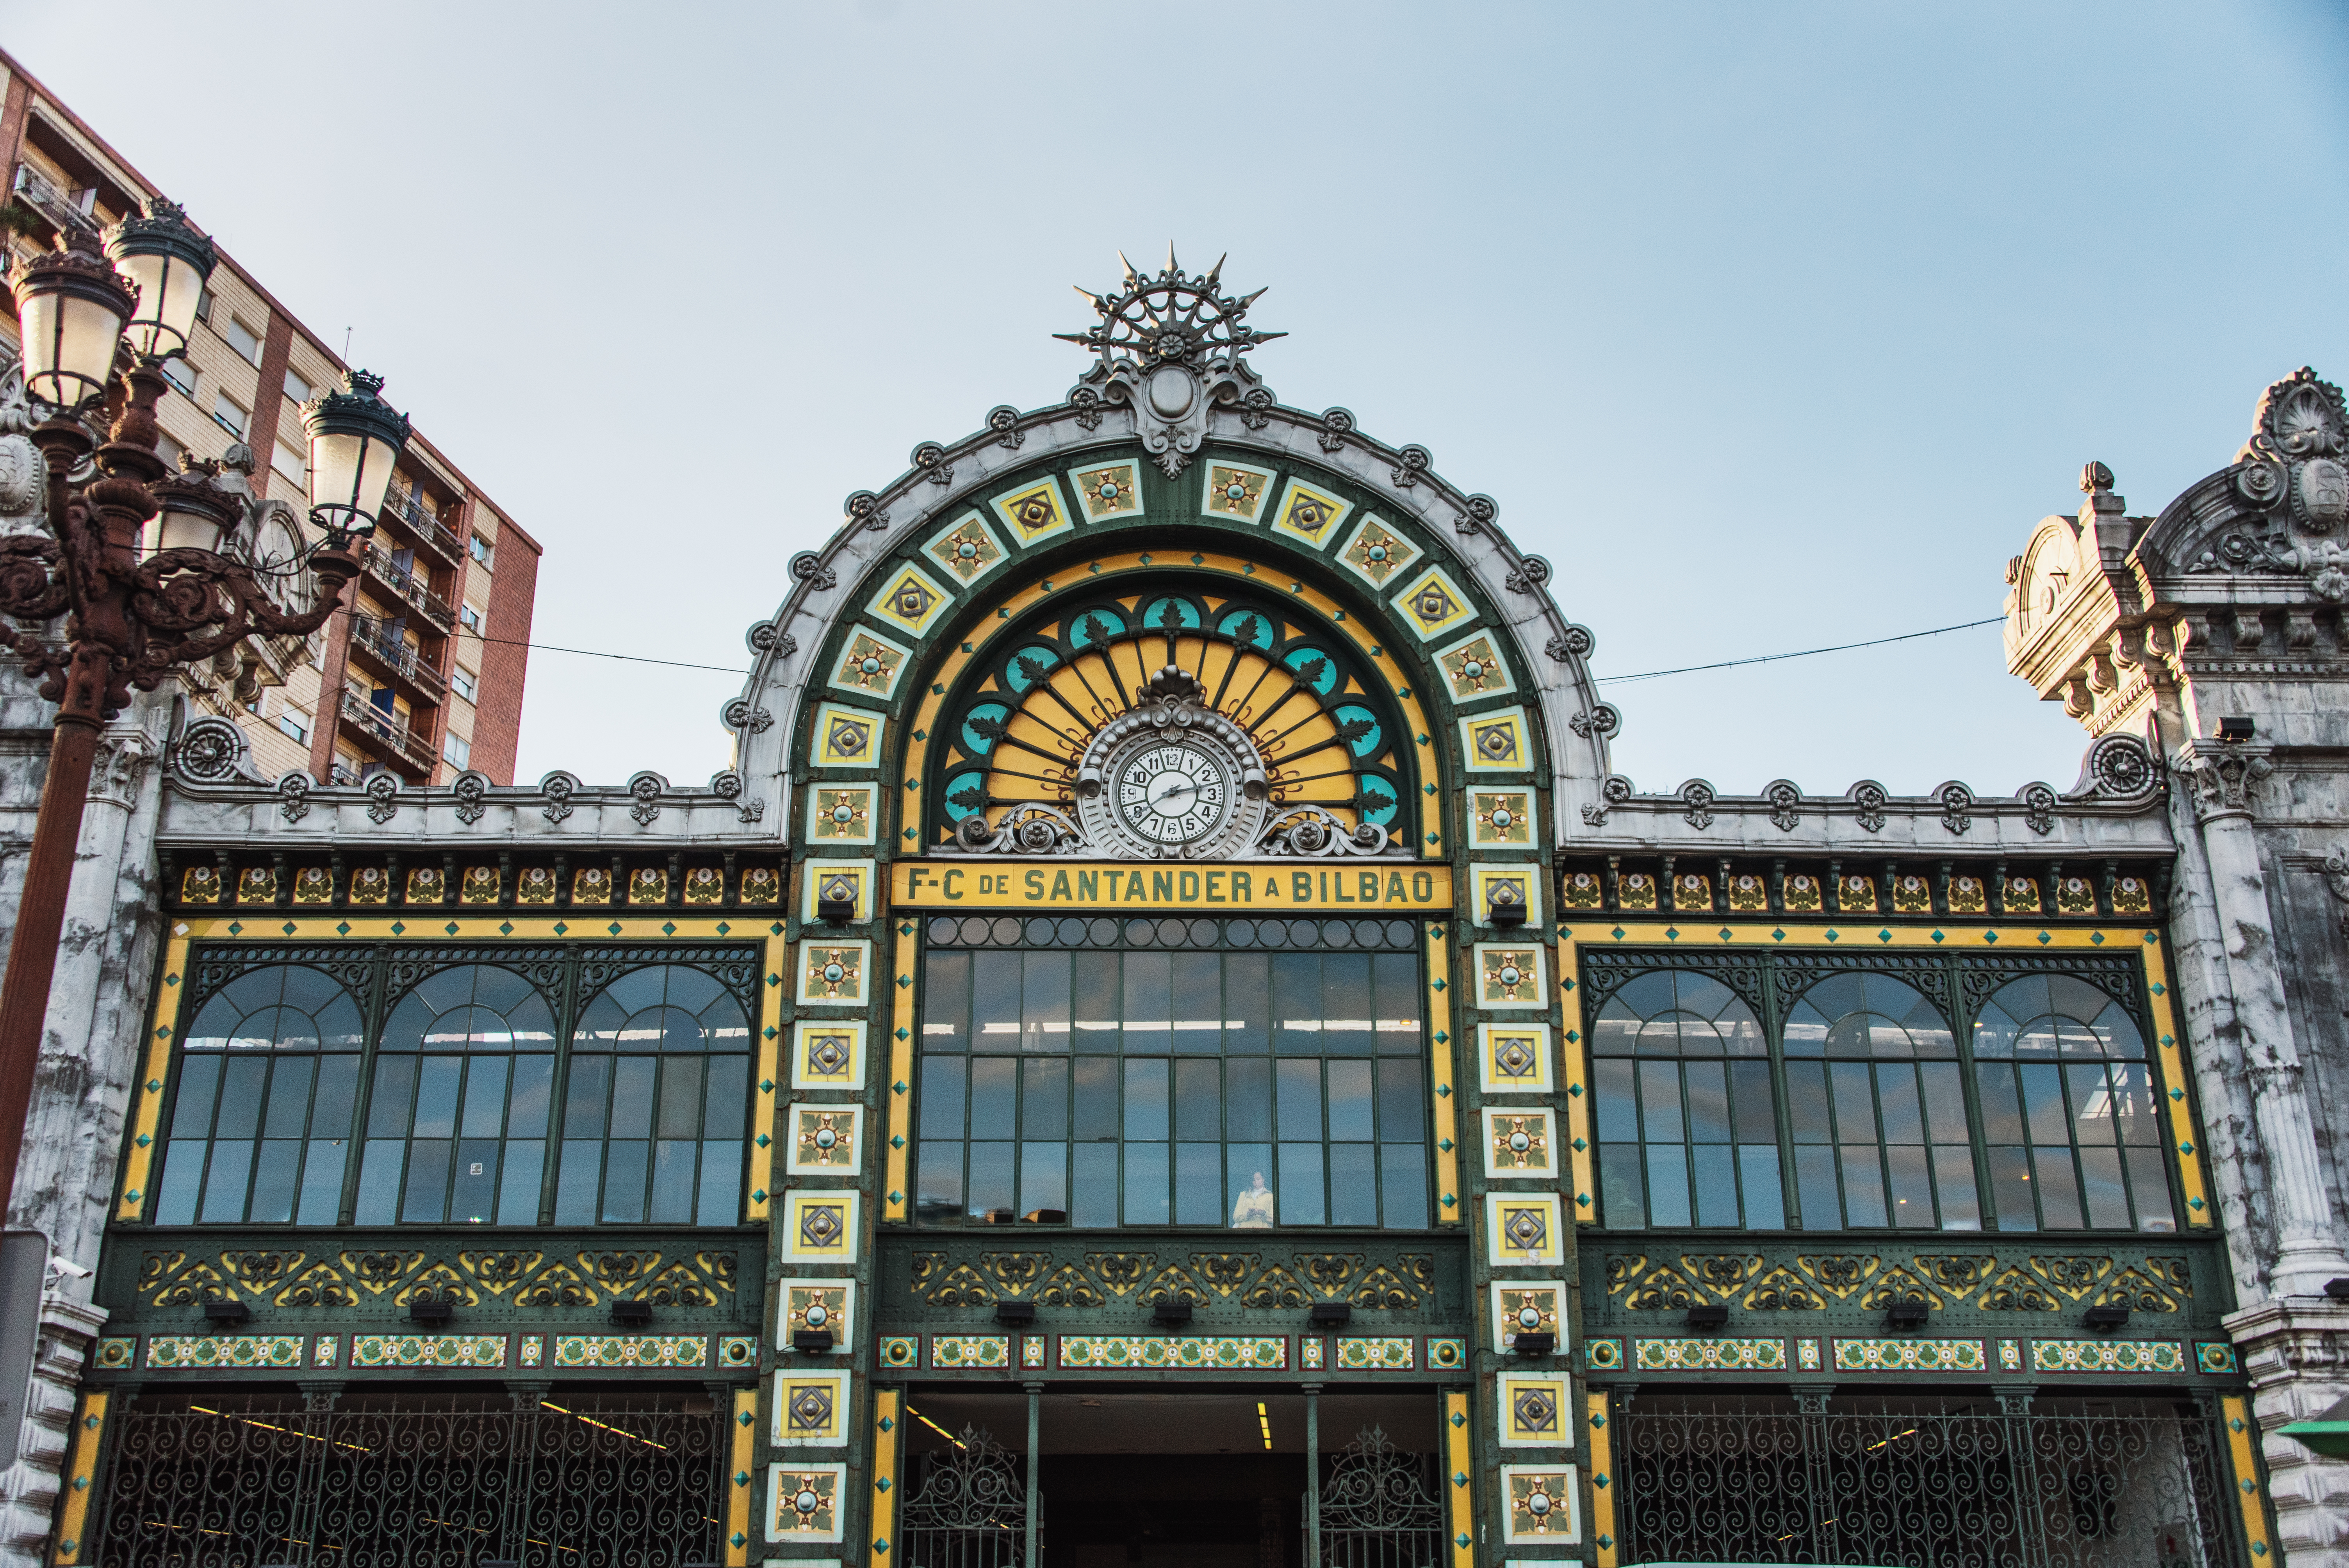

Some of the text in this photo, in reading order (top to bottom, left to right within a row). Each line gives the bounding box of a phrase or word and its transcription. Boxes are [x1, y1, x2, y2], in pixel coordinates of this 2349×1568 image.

[1148, 758, 1158, 770] 11
[1165, 754, 1178, 766] 12
[1189, 758, 1193, 770] 1
[1133, 771, 1146, 783] 10
[1202, 770, 1210, 782] 2
[1128, 788, 1136, 800] 9
[1207, 788, 1216, 800] 3
[1134, 805, 1142, 818] 8
[1201, 806, 1210, 818] 4
[1150, 819, 1158, 831] 7
[1167, 823, 1176, 834] 6
[1186, 818, 1194, 830] 5
[979, 875, 1009, 895] DE
[1024, 870, 1252, 902] SANTANDER
[1264, 877, 1280, 897] A
[1292, 871, 1433, 903] BILBAO
